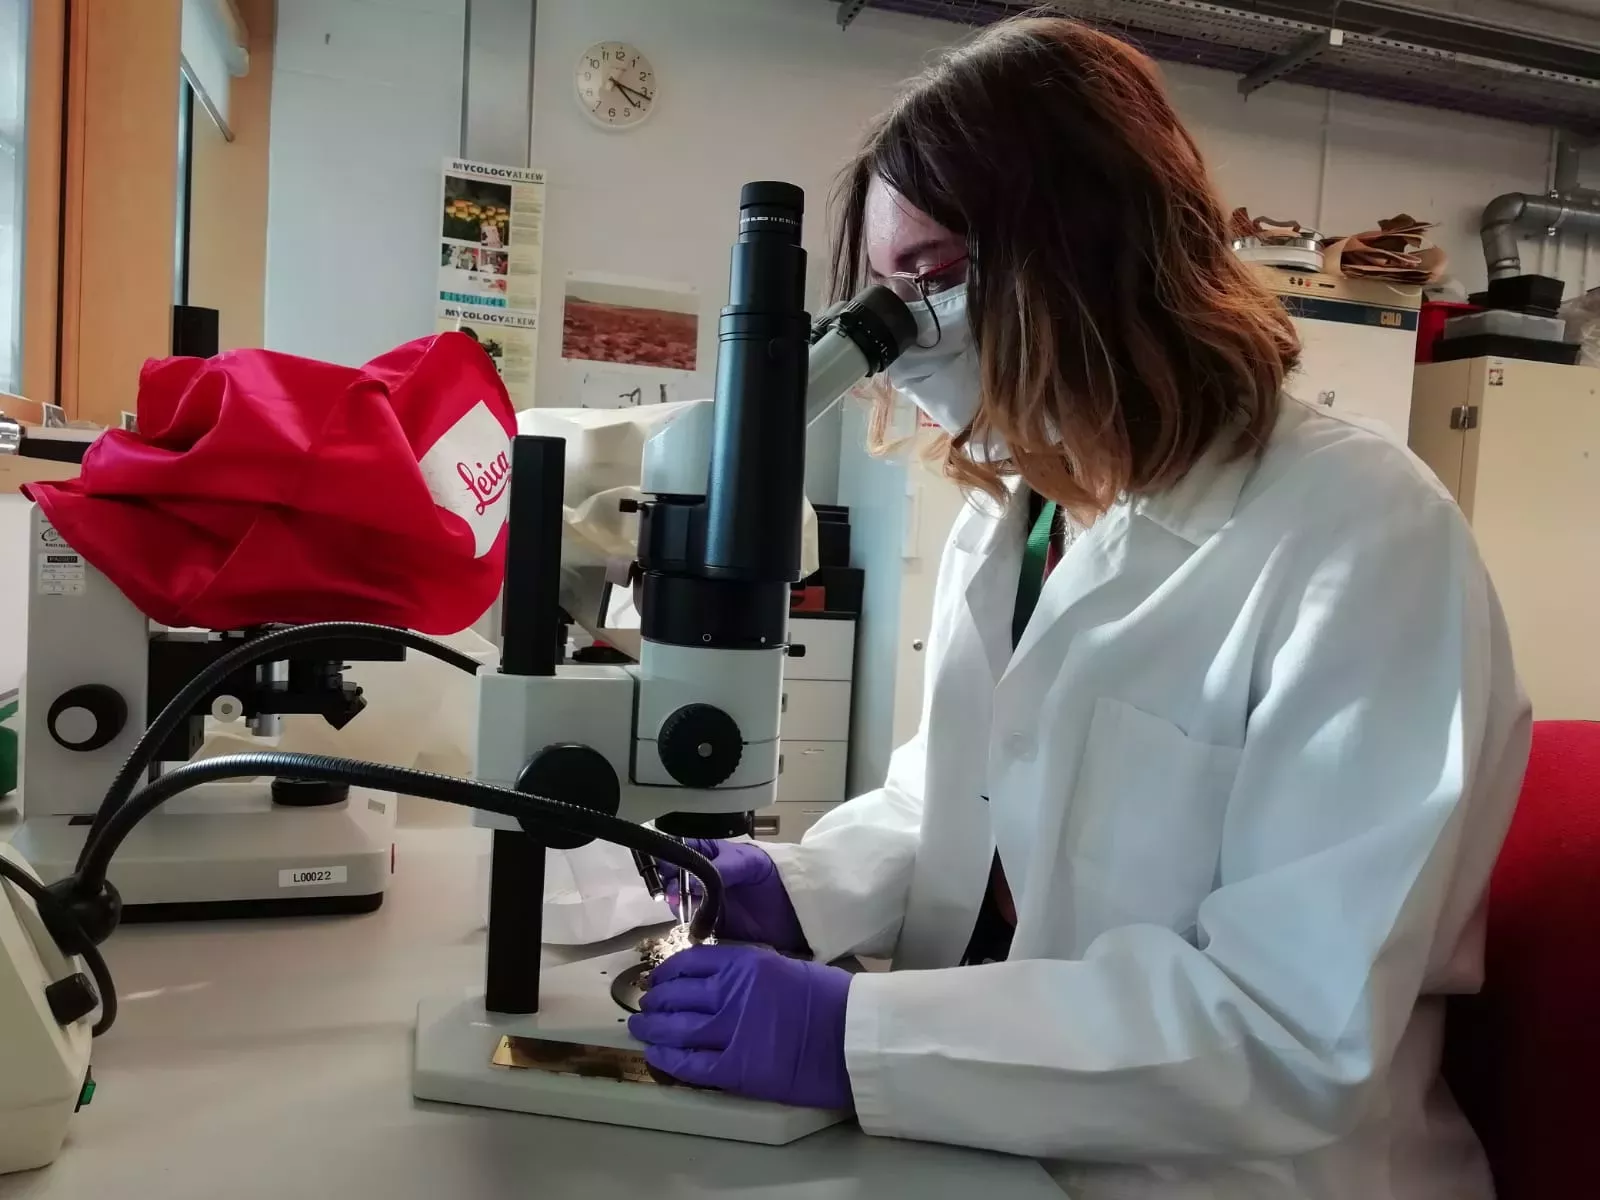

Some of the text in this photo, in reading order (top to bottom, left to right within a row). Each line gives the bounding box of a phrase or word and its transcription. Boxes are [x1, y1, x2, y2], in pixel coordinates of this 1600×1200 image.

[602, 51, 609, 61] 11
[616, 51, 625, 61] 12
[590, 59, 600, 70] 10
[585, 72, 591, 81] 9
[639, 72, 646, 81] 2
[640, 87, 647, 97] 3
[595, 101, 602, 110] 7
[608, 108, 616, 117] 6
[624, 108, 631, 117] 5
[452, 162, 512, 177] MYCOLOGY
[525, 172, 544, 181] KEW
[445, 308, 504, 322] MYCOLOGY
[517, 317, 535, 326] KEW
[456, 451, 512, 516] Leica
[293, 871, 332, 883] L00022
